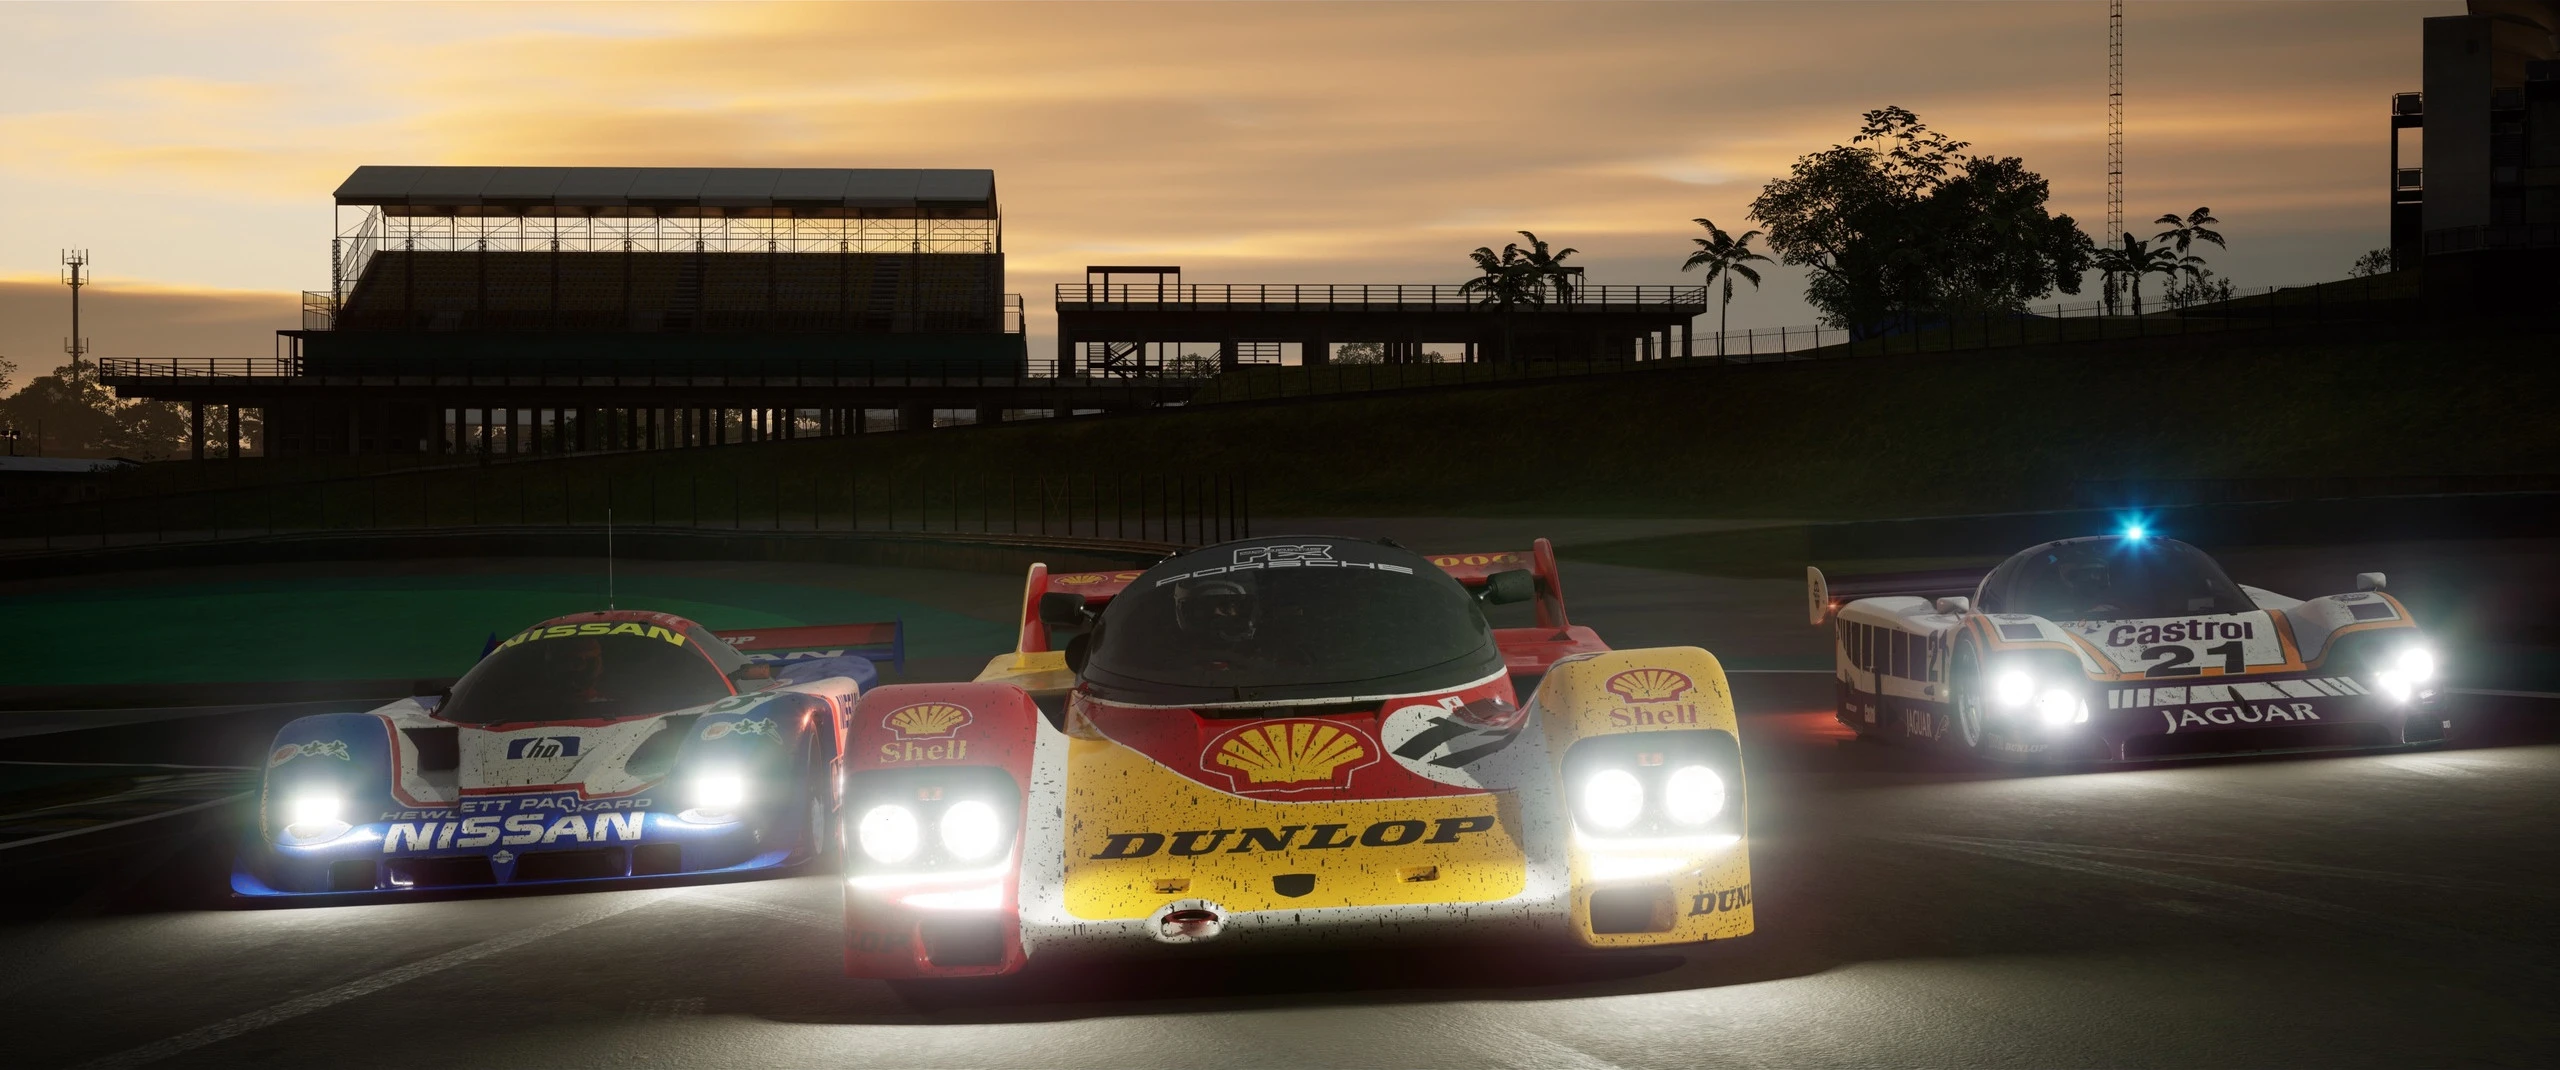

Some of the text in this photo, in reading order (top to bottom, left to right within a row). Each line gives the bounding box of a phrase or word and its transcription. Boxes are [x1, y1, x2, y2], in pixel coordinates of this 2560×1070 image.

[1155, 559, 1413, 589] PORSCHE
[491, 621, 687, 648] NISSAN
[2107, 619, 2254, 648] Castrol
[1928, 629, 1947, 683] 21
[2140, 641, 2244, 678] 21
[1609, 704, 1697, 728] Shell
[1905, 708, 1932, 737] JAGUAR
[2160, 703, 2320, 734] JAGUAR
[880, 739, 967, 763] Shell
[380, 799, 505, 821] HEWLETT
[382, 811, 645, 853] NISSAN
[1089, 815, 1495, 860] DUNLOP
